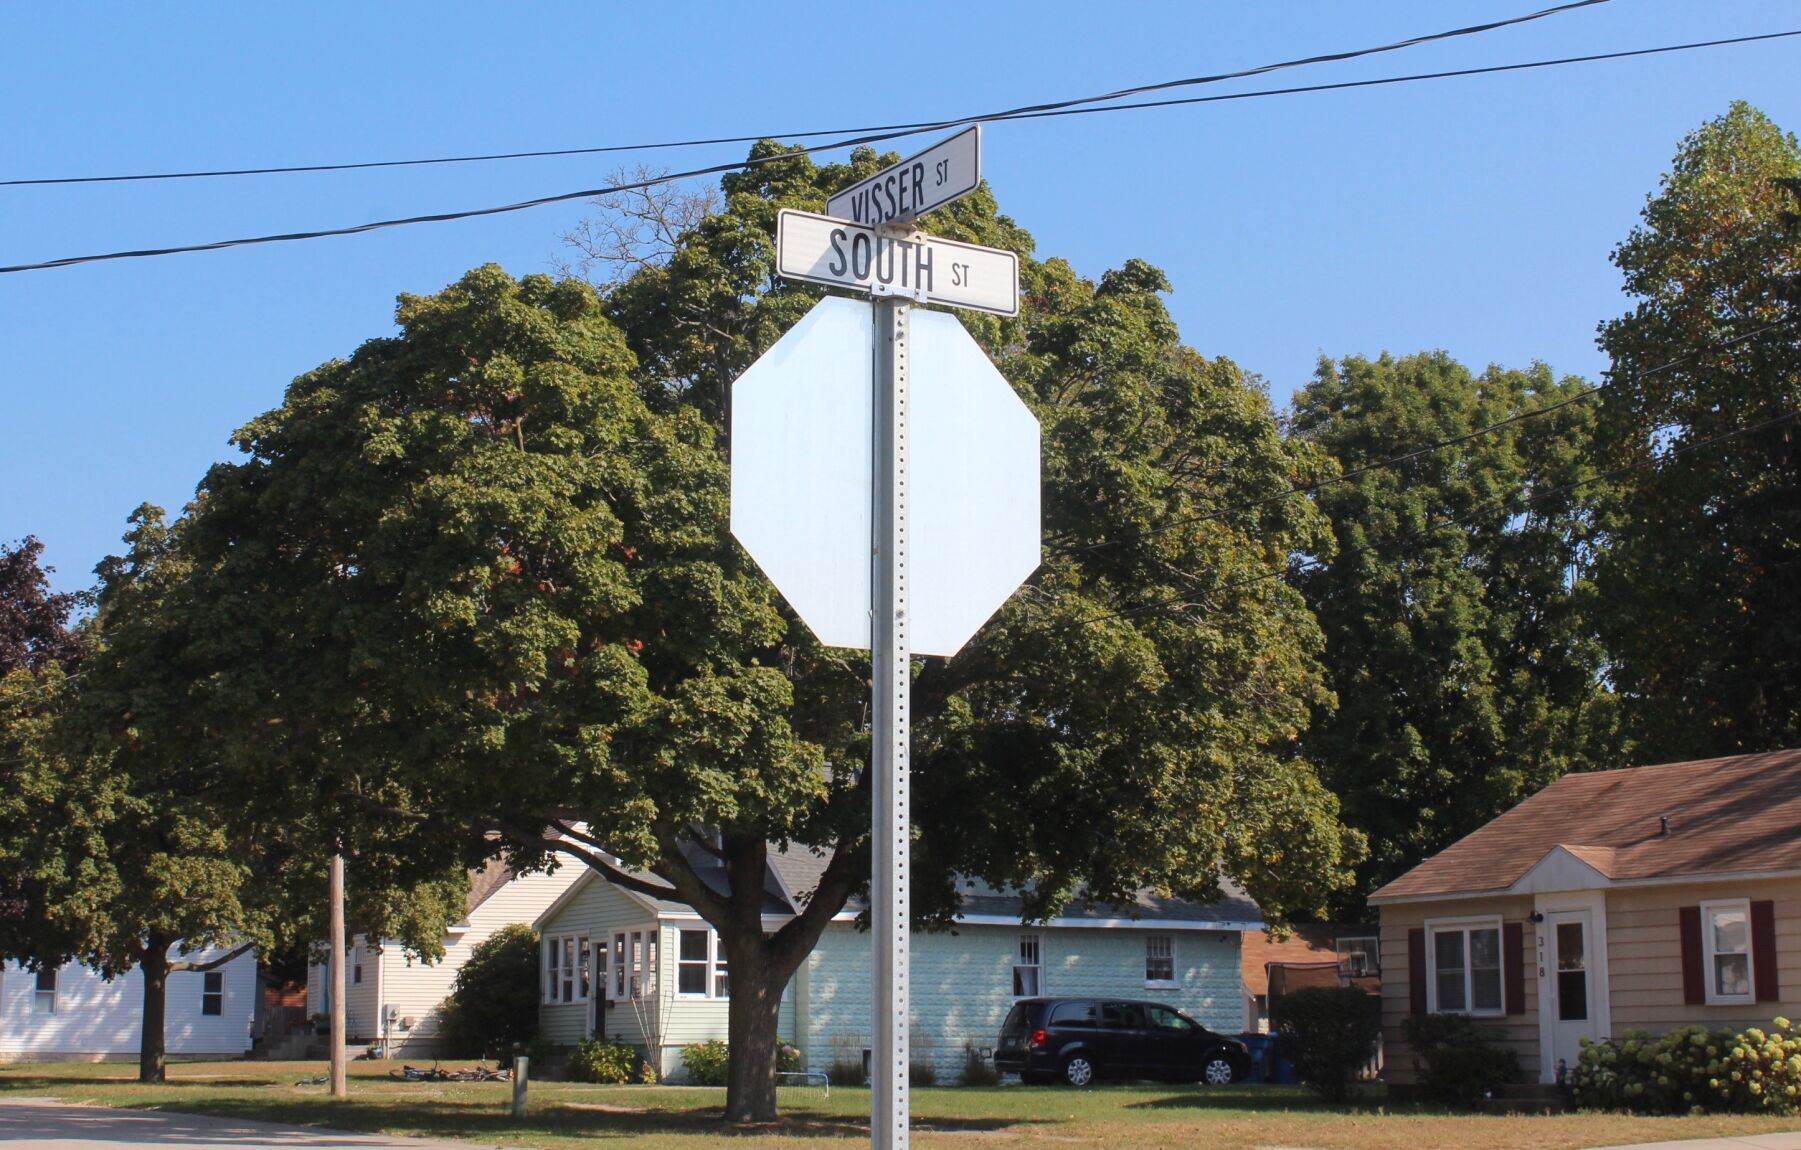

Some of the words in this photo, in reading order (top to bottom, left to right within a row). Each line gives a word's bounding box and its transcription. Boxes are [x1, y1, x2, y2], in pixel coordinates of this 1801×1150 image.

[852, 163, 925, 224] VISSER
[936, 159, 949, 186] ST
[829, 229, 933, 292] SOUTH
[951, 263, 970, 287] ST
